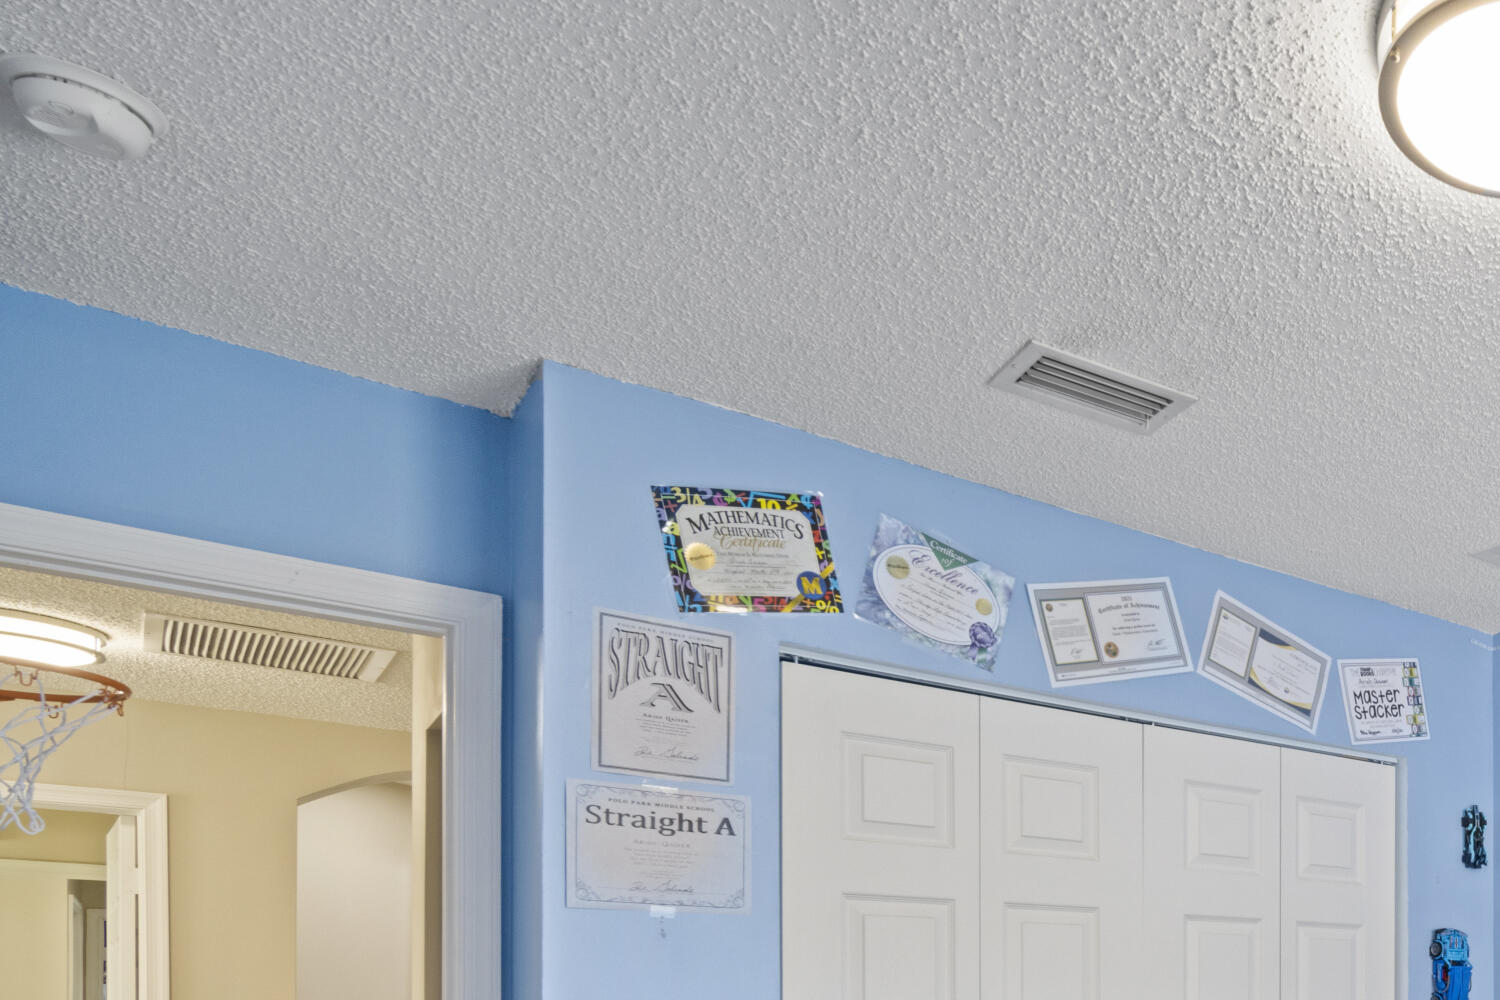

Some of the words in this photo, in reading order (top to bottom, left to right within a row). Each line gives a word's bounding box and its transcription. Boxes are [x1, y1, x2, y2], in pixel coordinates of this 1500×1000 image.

[686, 510, 804, 540] MATHEMATICS
[713, 526, 784, 539] ACHIEVEMENT
[713, 535, 786, 551] Certificate
[929, 540, 968, 564] Certificate
[801, 576, 823, 595] M
[909, 550, 979, 594] Excellence
[608, 628, 723, 714] STRAIGHT
[640, 682, 694, 712] A
[1353, 689, 1400, 705] Master
[585, 804, 709, 837] Straight
[714, 816, 737, 837] A
